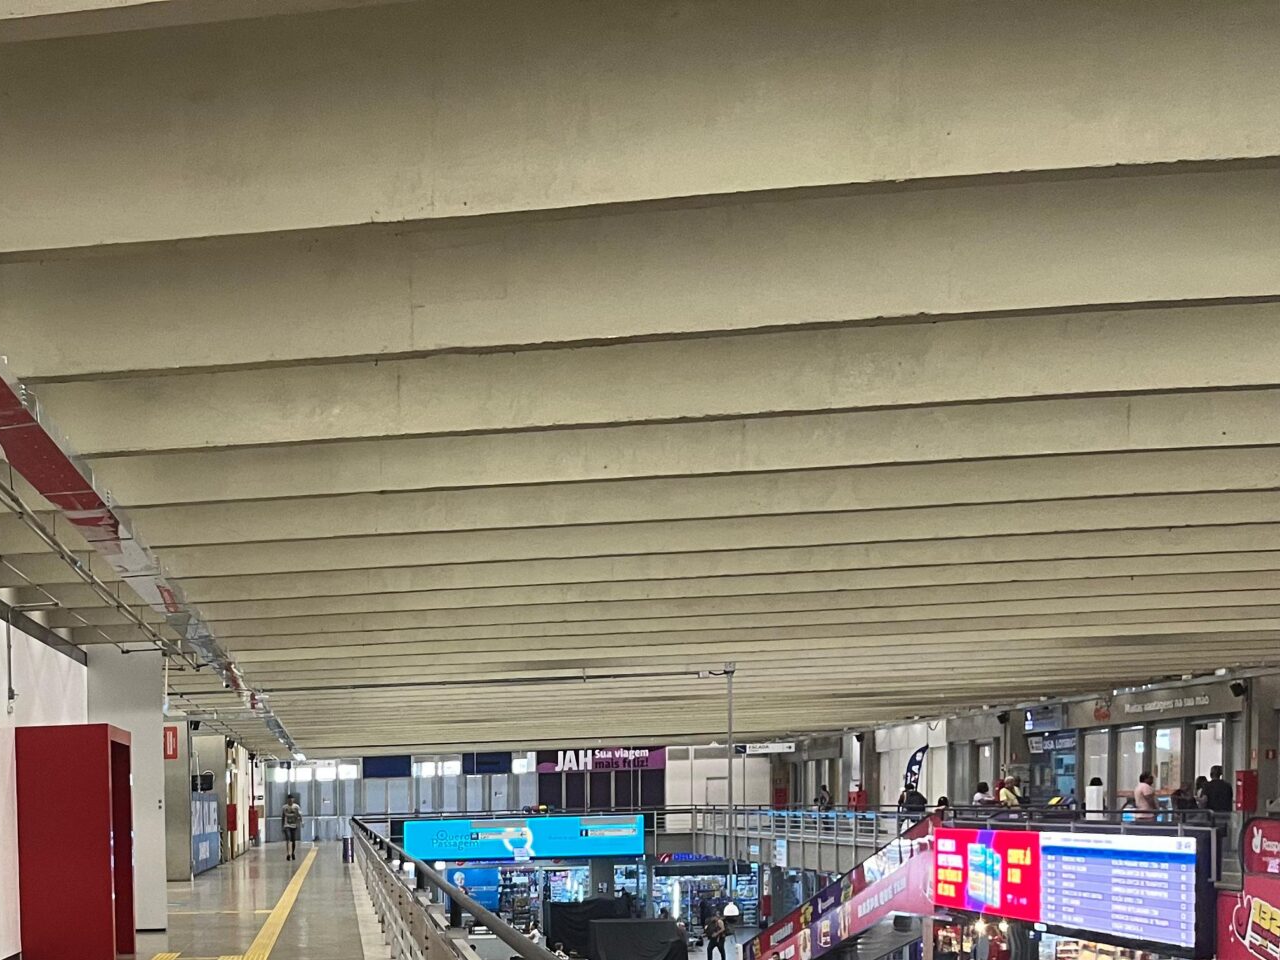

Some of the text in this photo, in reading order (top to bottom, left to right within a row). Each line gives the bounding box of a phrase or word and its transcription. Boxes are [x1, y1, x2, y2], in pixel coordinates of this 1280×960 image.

[555, 748, 649, 772] JAH Sua viagem
[595, 759, 620, 769] mais
[437, 830, 470, 841] Quero
[432, 838, 479, 851] Passagem
